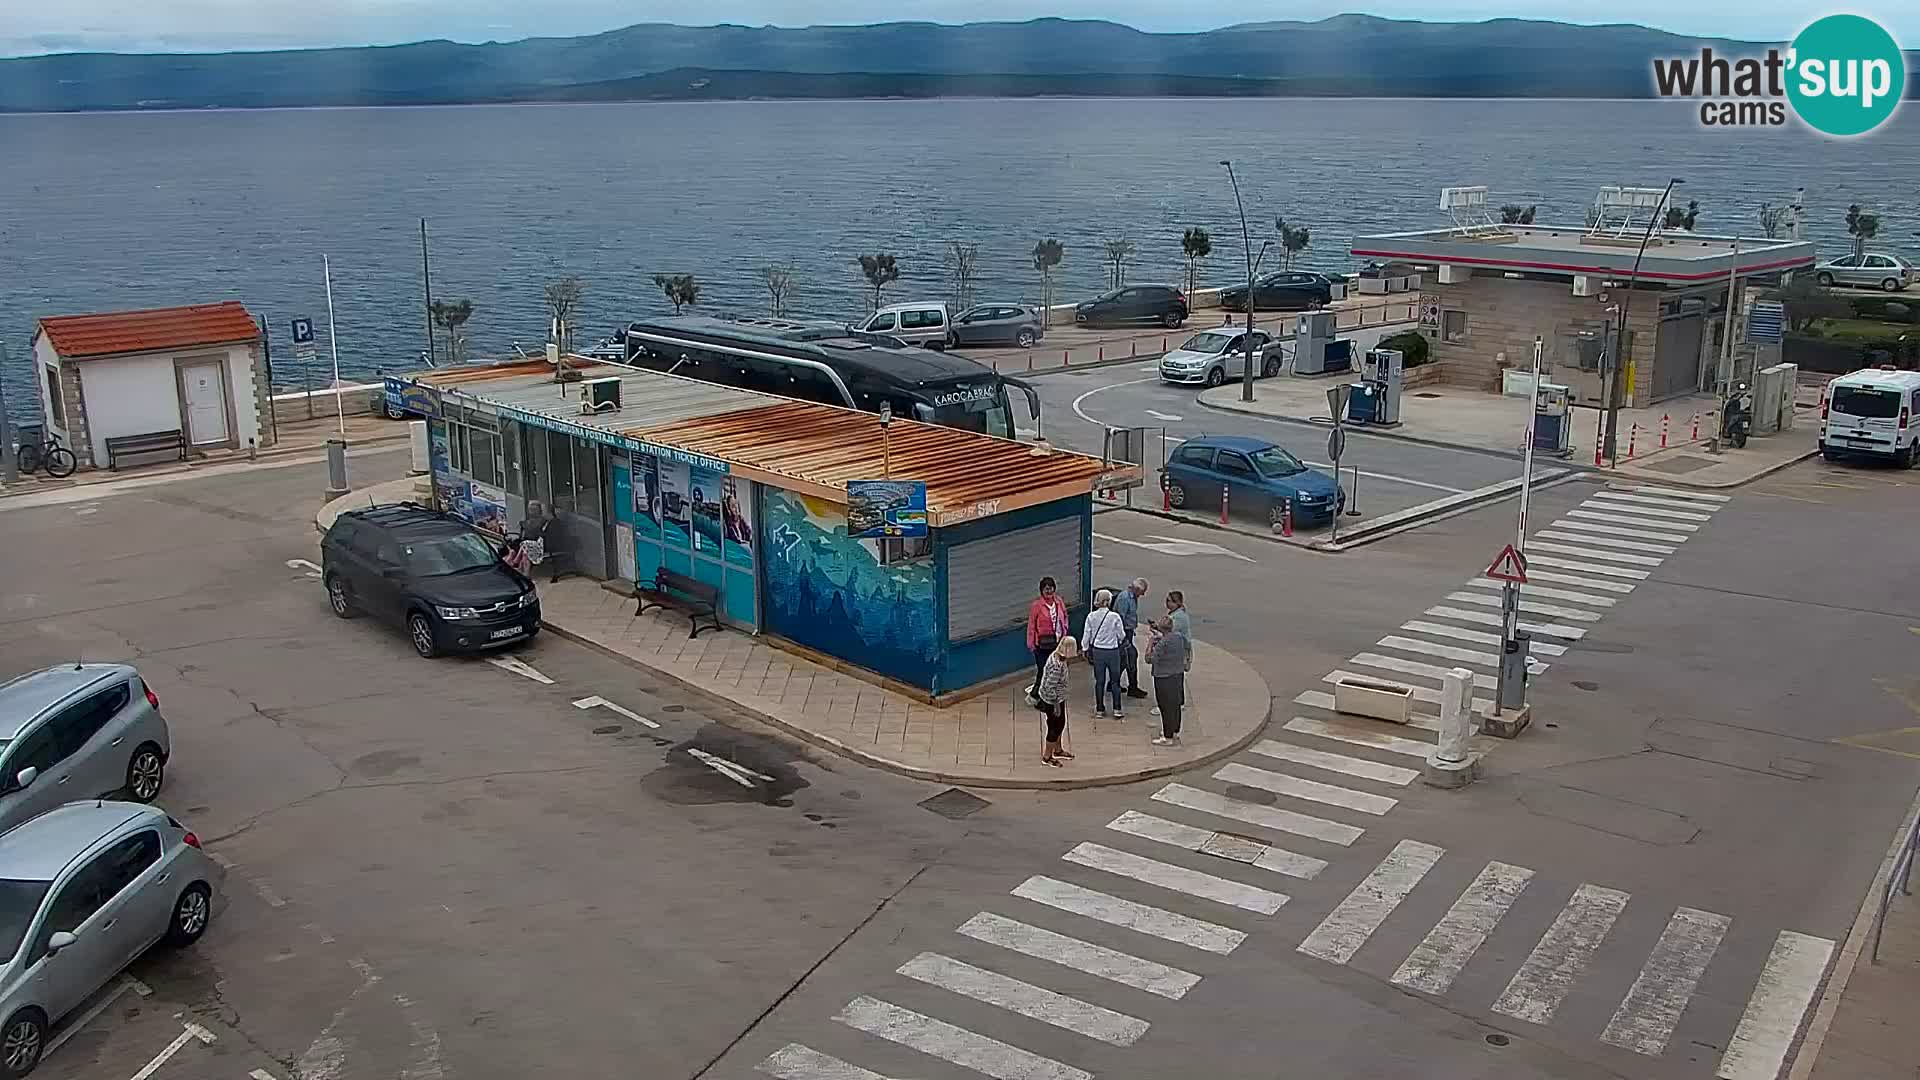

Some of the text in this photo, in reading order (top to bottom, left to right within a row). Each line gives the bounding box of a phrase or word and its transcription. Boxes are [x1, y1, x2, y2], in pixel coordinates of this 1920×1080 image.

[296, 322, 308, 340] P
[585, 428, 616, 445] POSTAJA
[625, 439, 640, 451] BUS
[640, 443, 671, 458] STATION
[672, 450, 698, 465] TICKET
[699, 456, 726, 472] OFFICE
